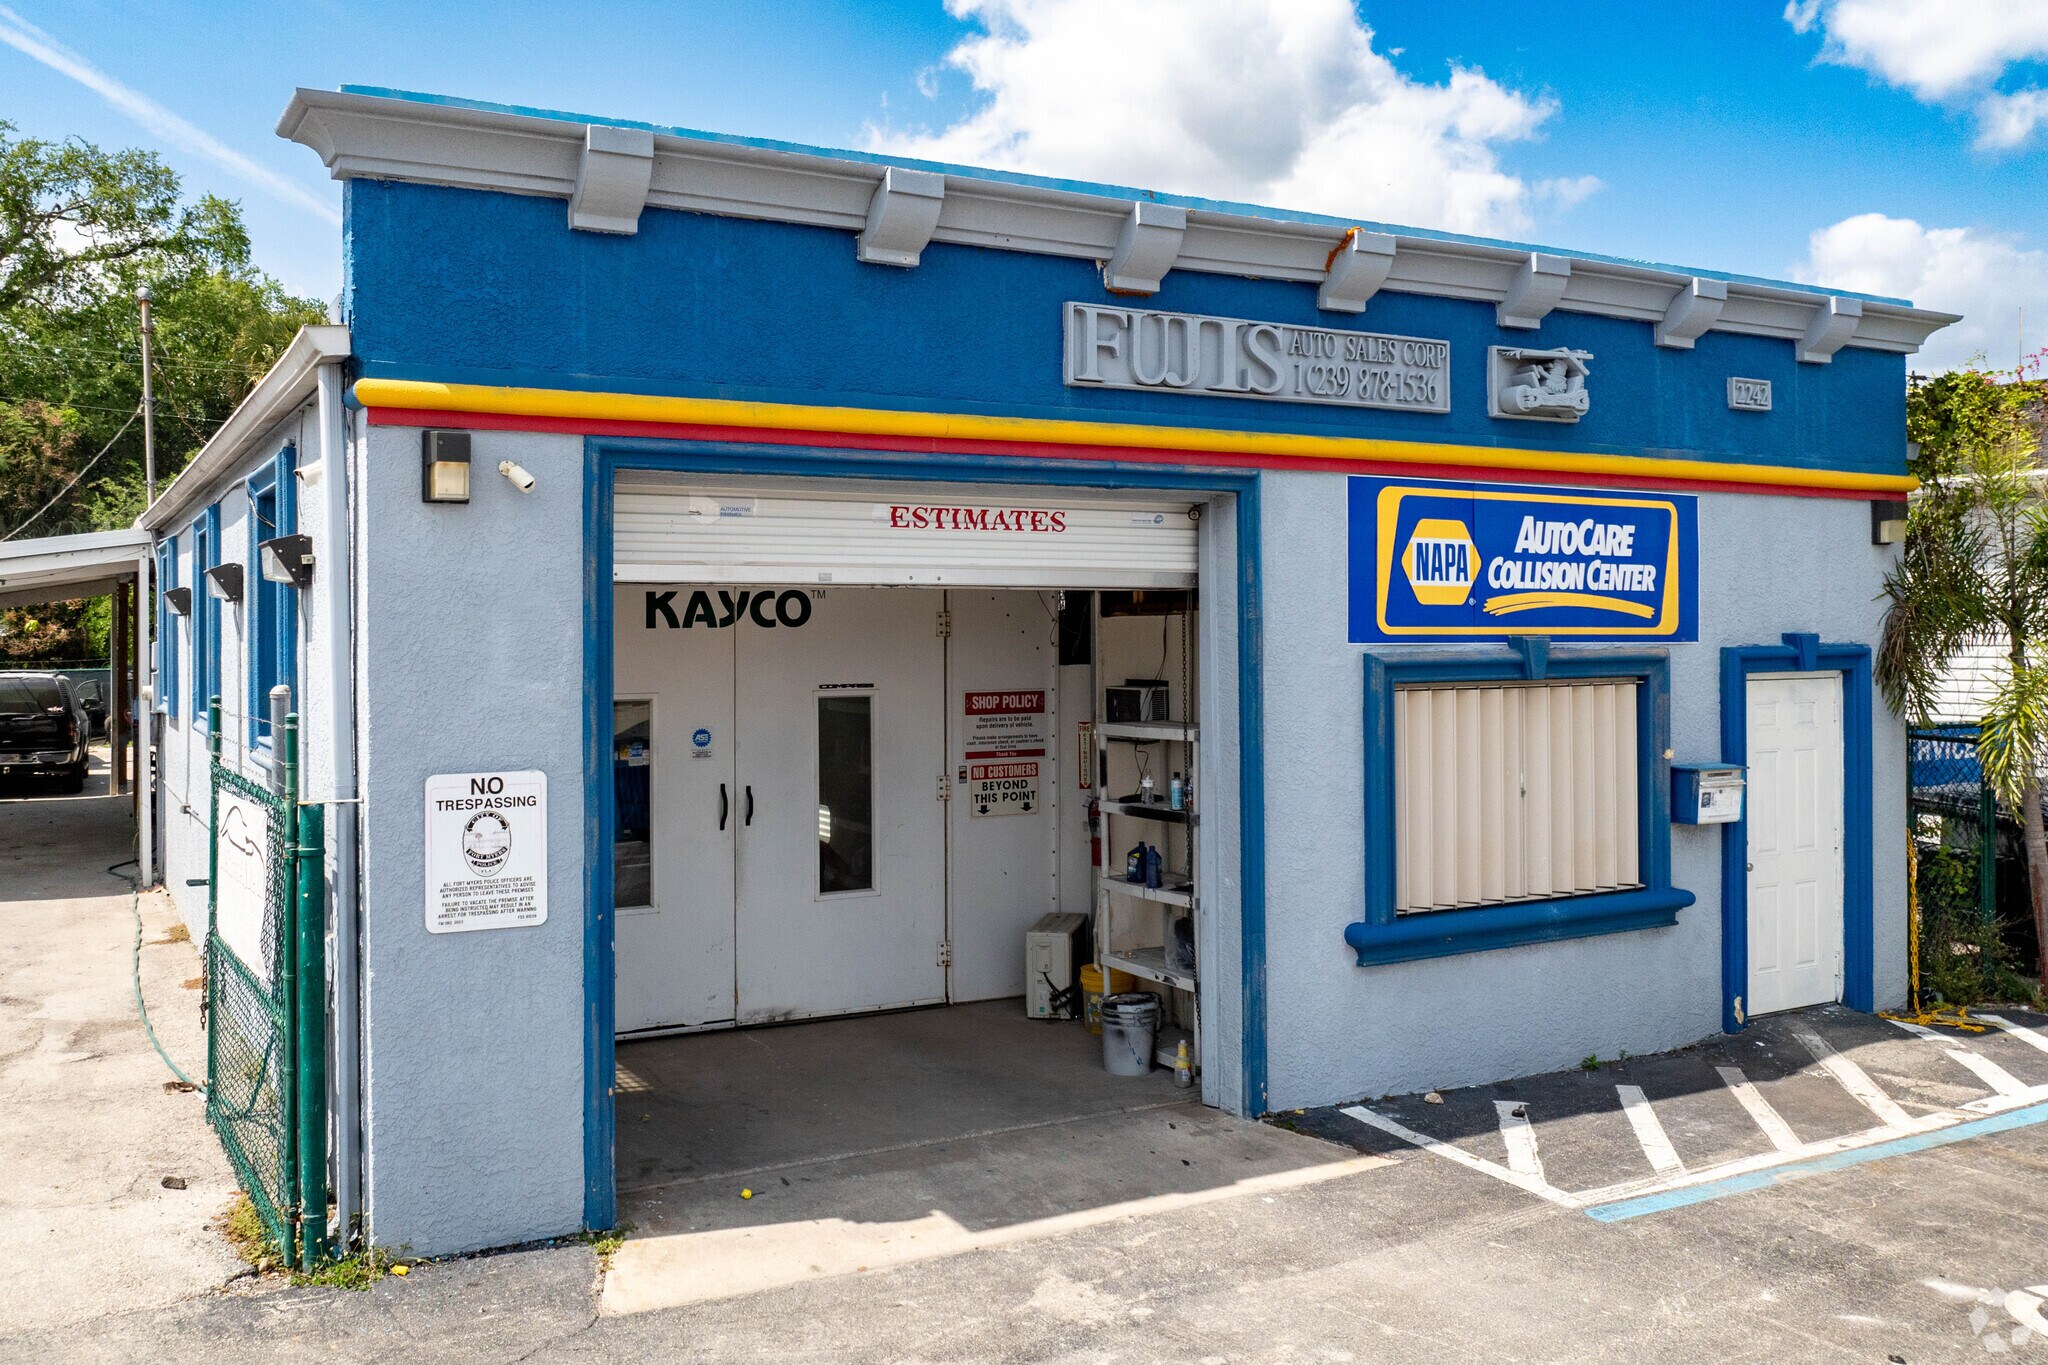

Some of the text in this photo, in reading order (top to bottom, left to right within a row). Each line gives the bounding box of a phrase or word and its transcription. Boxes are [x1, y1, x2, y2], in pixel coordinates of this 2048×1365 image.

[1073, 305, 1286, 395] FUJIS
[1288, 331, 1447, 369] AUTO SALES CORP
[1358, 367, 1438, 403] 878-1536
[889, 506, 1067, 533] ESTIMATES
[1416, 542, 1469, 582] NAPA
[645, 589, 812, 629] KAYCO
[972, 694, 1038, 710] SHOP POLICY
[695, 733, 709, 742] ASE
[973, 763, 1037, 779] NO CUSTOMERS
[470, 776, 504, 795] NO
[982, 780, 1028, 791] BEYOND
[436, 796, 537, 811] TRESPASSING
[974, 790, 1036, 804] THIS POINT
[471, 812, 503, 824] CITY OF
[468, 849, 484, 859] FORT
